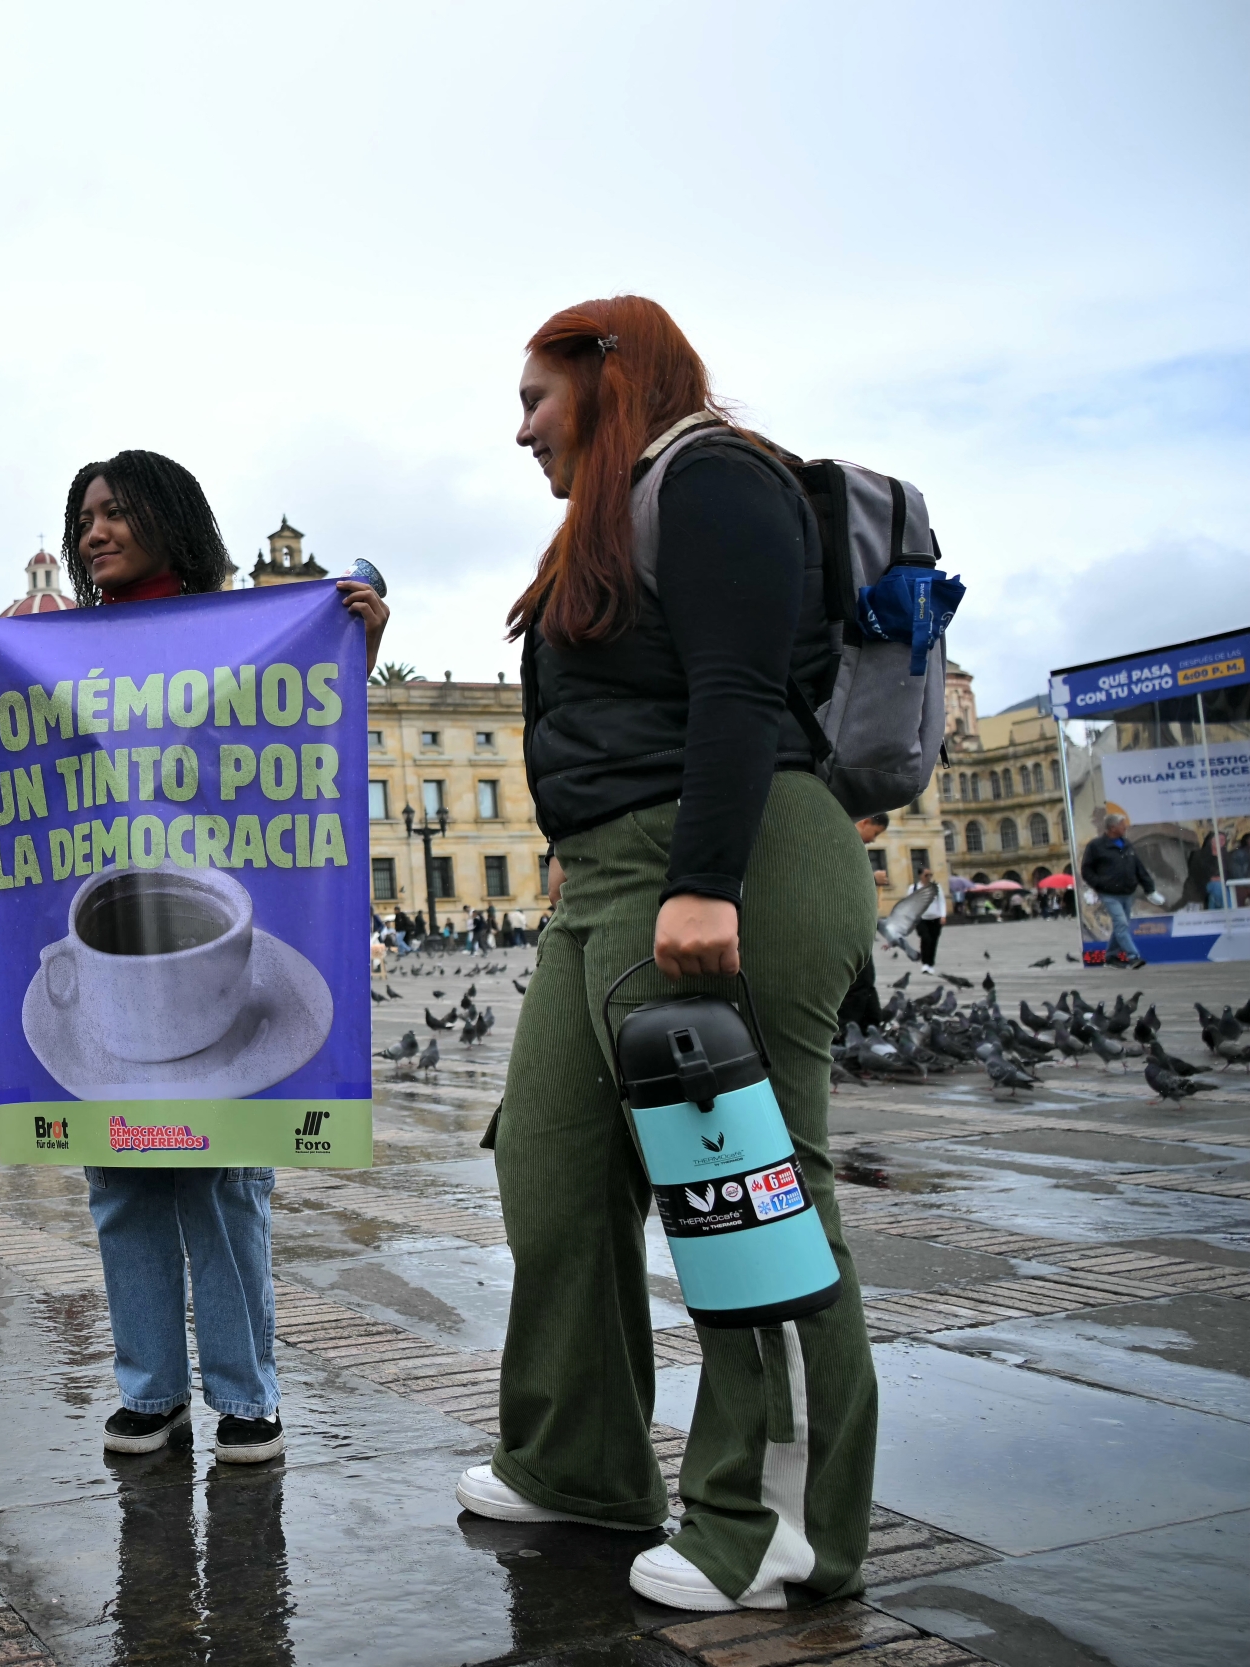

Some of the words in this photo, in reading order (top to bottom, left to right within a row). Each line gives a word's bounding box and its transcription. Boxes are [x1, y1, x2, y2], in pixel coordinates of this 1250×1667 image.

[1179, 655, 1213, 669] DESPUÉS
[1214, 652, 1225, 660] DE
[1227, 648, 1242, 659] LAS
[1098, 669, 1129, 690] QUÉ
[1131, 663, 1172, 682] PASA
[1183, 668, 1209, 681] 4:00
[1076, 690, 1107, 706] CON
[1109, 685, 1129, 700] TU
[1131, 676, 1173, 695] VOTO
[1167, 760, 1195, 771] LOS
[1198, 753, 1250, 768] TESTIG
[56, 744, 199, 812] TINTO
[220, 743, 341, 801] POR
[1118, 772, 1176, 785] VIGILAN
[1180, 770, 1197, 780] EL
[49, 812, 349, 882] DEMOCRACIA
[34, 1116, 69, 1139] Brot
[109, 1117, 121, 1127] LA
[110, 1126, 186, 1137] DEMOCRACIA
[36, 1139, 46, 1149] für
[47, 1139, 55, 1149] die
[56, 1139, 69, 1149] Welt
[110, 1137, 131, 1149] QUE
[132, 1137, 203, 1149] QUEREMOS
[295, 1138, 331, 1151] Foro
[768, 1173, 779, 1189] 6
[772, 1193, 789, 1212] 12
[710, 1219, 743, 1230] THERMOS
